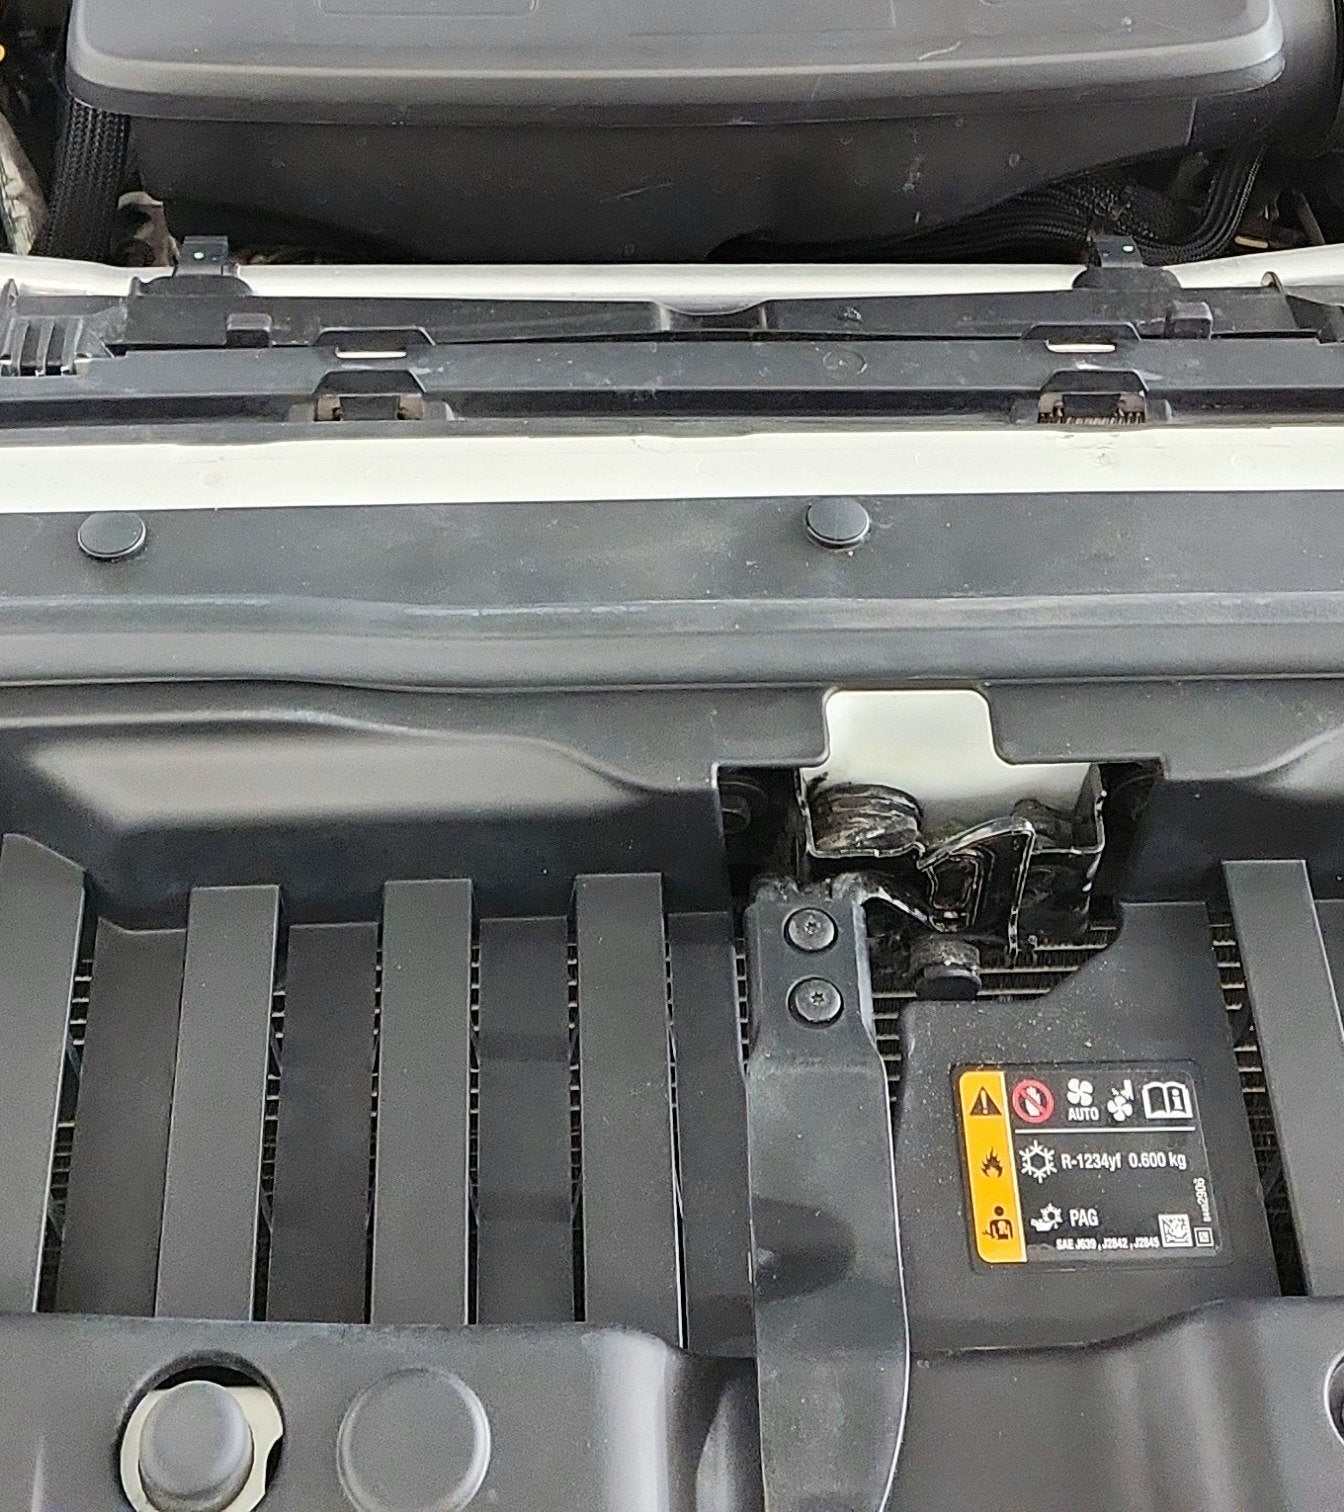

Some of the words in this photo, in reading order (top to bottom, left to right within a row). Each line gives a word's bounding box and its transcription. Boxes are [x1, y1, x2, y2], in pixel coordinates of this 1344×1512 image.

[1068, 1107, 1100, 1122] AUTO
[1061, 1153, 1123, 1171] R-1234yf
[1128, 1152, 1166, 1169] 0.600
[1168, 1151, 1187, 1171] kg
[1069, 1209, 1099, 1228] PAG
[1056, 1238, 1074, 1250] SAE
